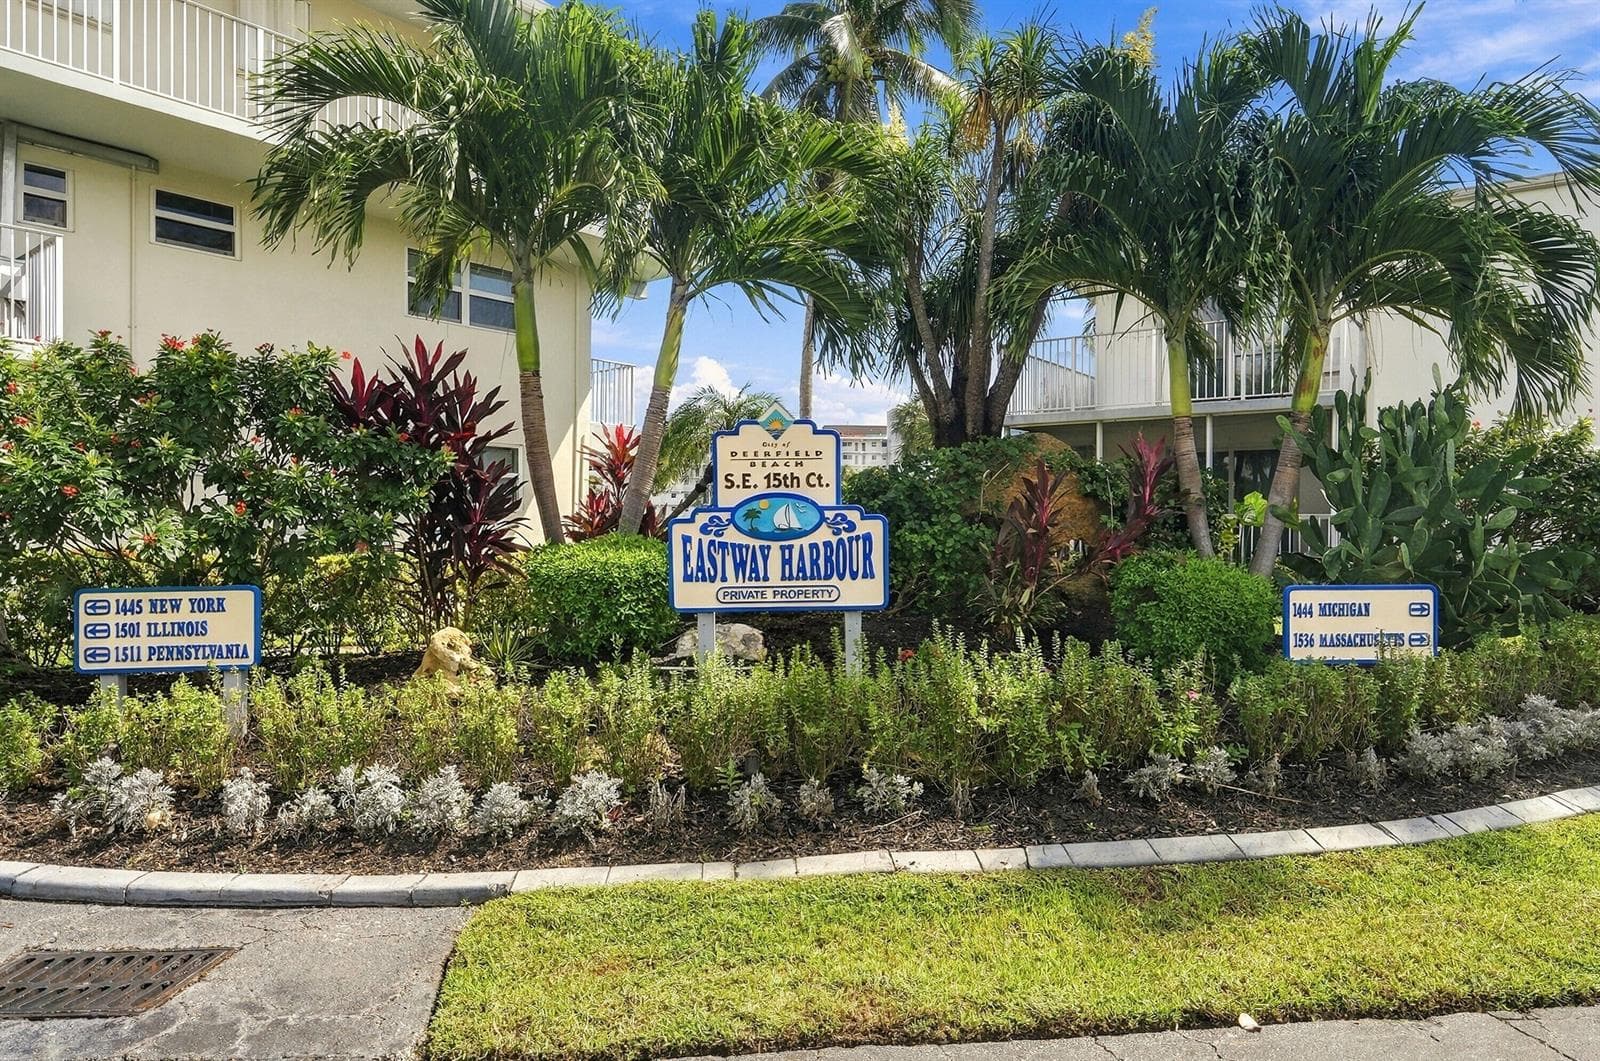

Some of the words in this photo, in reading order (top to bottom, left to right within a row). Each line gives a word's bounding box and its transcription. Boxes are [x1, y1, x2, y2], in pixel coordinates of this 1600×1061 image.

[724, 473, 758, 489] S.E.
[764, 472, 800, 489] 15th
[806, 472, 830, 488] Ct.
[681, 534, 771, 583] EASTWAY
[780, 532, 875, 581] HARBOUR
[723, 590, 768, 600] PRIVATE
[773, 589, 834, 599] PROPERTY
[115, 599, 143, 615] 1445
[149, 599, 183, 613] NEW
[189, 598, 226, 613] YORK
[1293, 603, 1313, 618] 1444
[1319, 603, 1370, 616] MICHIGAN
[115, 622, 141, 638] 1501
[147, 620, 208, 637] ILLINOIS
[1293, 633, 1314, 647] 1536
[115, 645, 142, 662] 1511
[148, 644, 249, 661] PENNSYLVANIA
